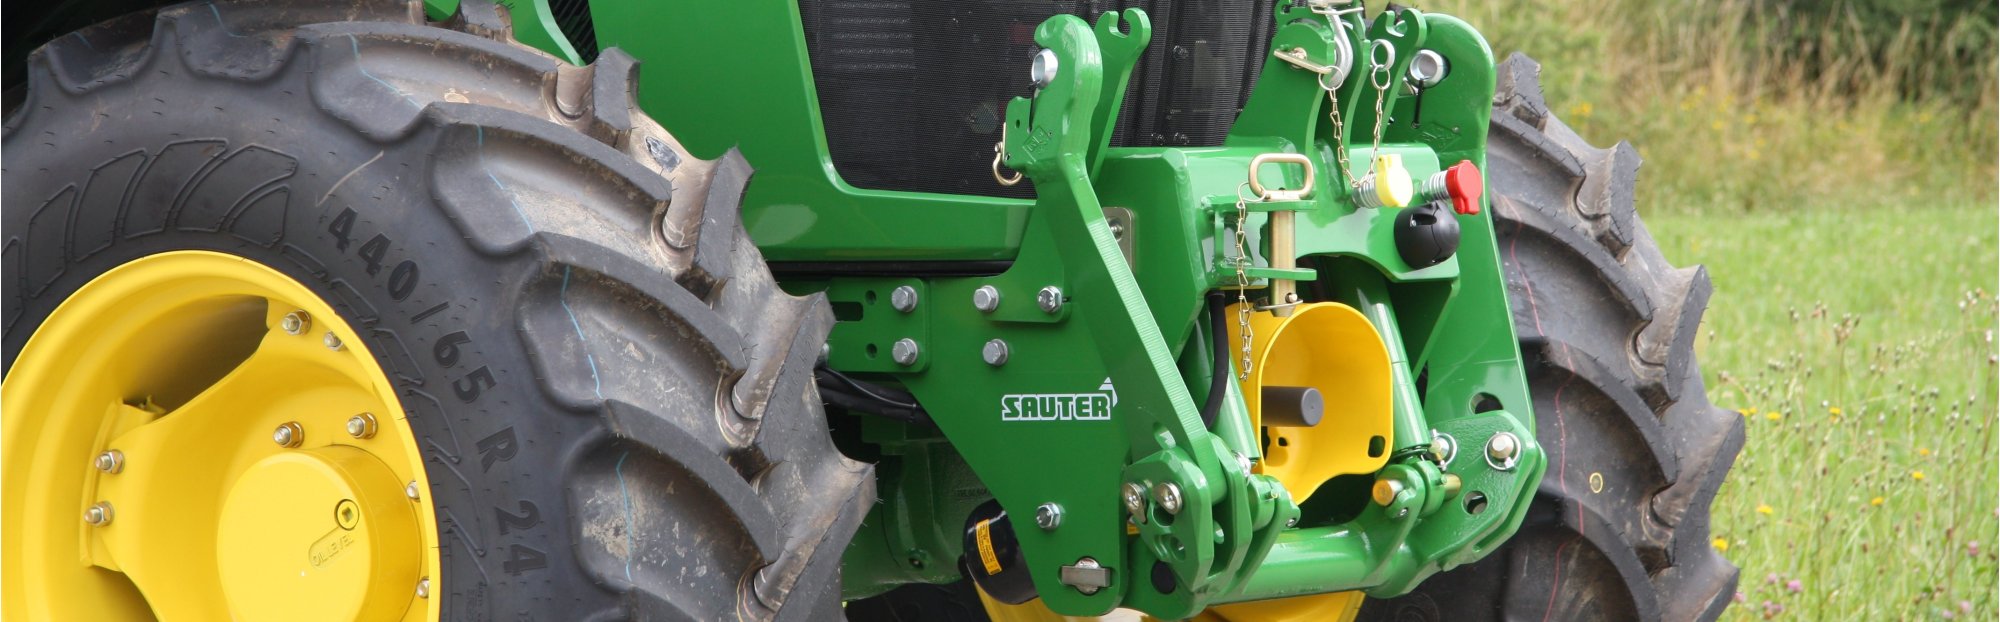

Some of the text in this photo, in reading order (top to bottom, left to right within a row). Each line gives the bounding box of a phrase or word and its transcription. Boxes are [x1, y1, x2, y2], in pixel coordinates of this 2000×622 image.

[1001, 393, 1111, 421] SAUTER
[476, 426, 520, 474] R
[312, 534, 355, 567] OIL LEVEL
[495, 500, 548, 577] 24
